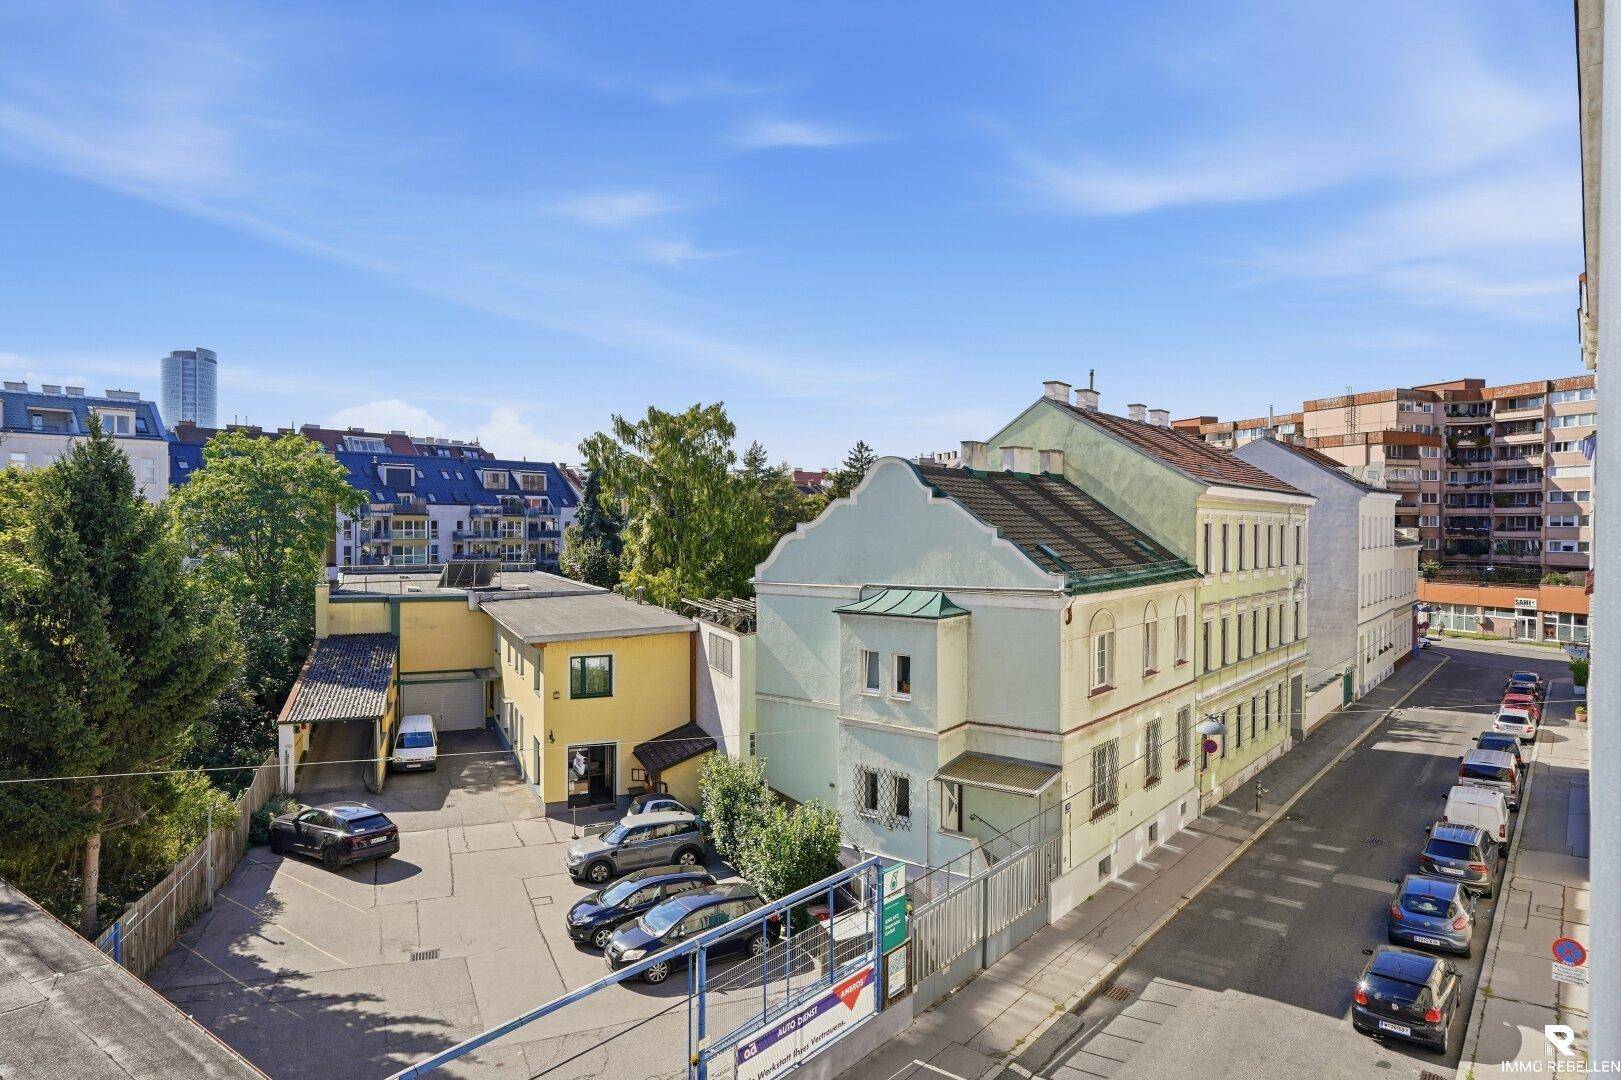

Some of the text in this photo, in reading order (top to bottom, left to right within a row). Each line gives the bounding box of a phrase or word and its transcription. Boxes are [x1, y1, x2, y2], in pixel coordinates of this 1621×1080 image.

[778, 1006, 818, 1037] AUTO DIENST
[757, 1053, 792, 1080] Werkstatt
[793, 1042, 810, 1058] Ihres
[810, 1020, 846, 1045] Vertrauens.
